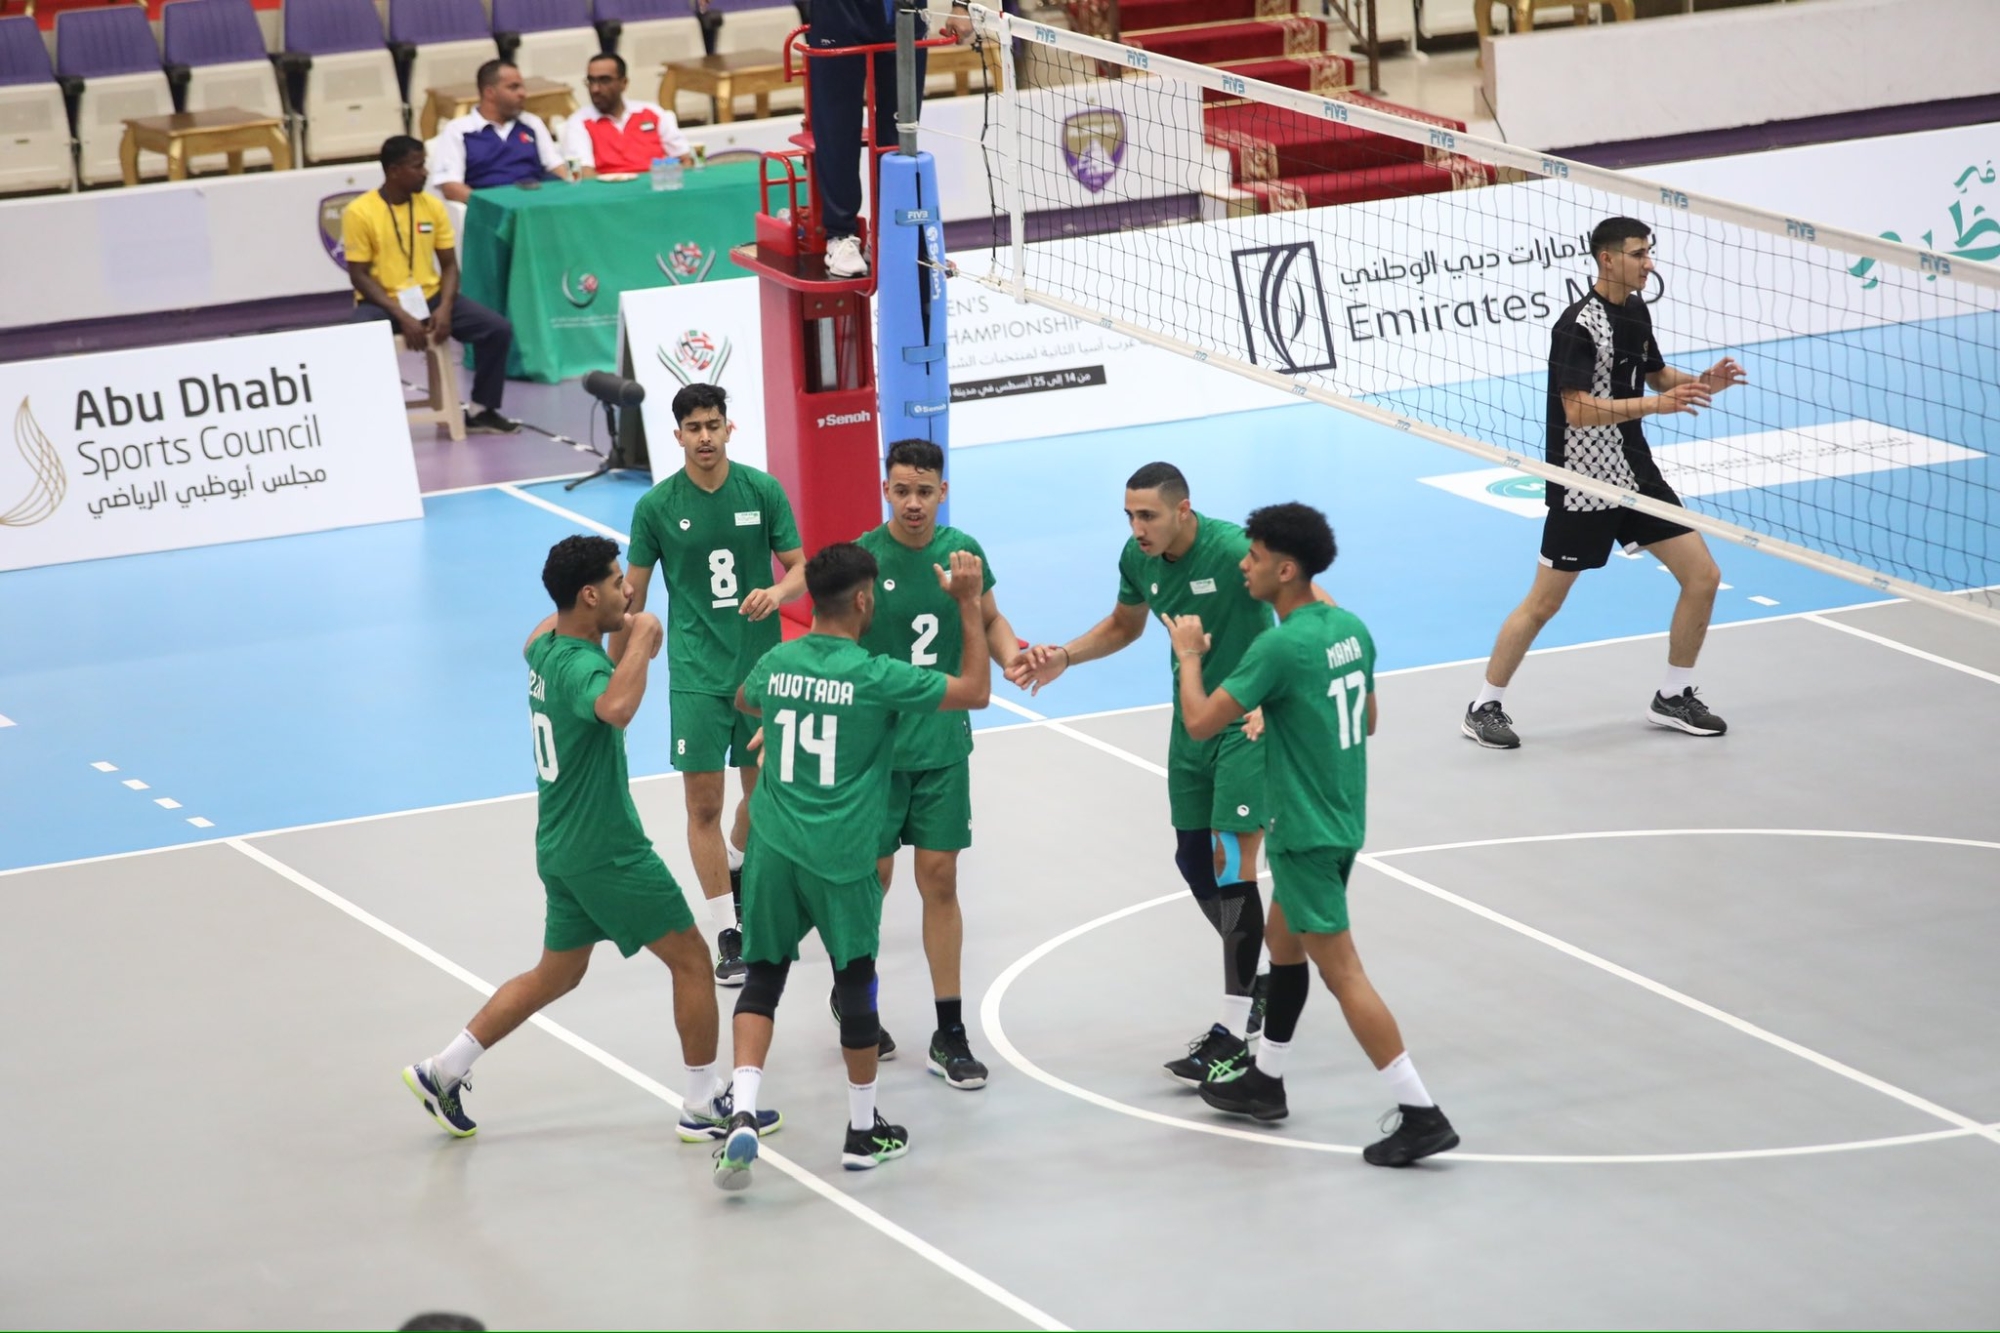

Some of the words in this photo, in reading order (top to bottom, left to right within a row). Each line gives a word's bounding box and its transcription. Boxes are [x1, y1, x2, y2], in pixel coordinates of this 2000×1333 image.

[1127, 49, 1149, 69] FIVB
[1222, 74, 1245, 94] FIVB
[1324, 101, 1348, 122] FIVB
[1430, 129, 1455, 149] FIVB
[1542, 157, 1569, 179] FIVB
[1660, 187, 1689, 209] FIVB
[907, 210, 929, 220] FIVB
[1785, 218, 1816, 242] FIVB
[1444, 249, 1500, 280] دبي
[1919, 251, 1951, 276] FIVB
[947, 295, 989, 318] EN'S
[1346, 290, 1551, 341] Emirates
[947, 317, 1083, 345] HAMPIONSHIP
[75, 387, 164, 430] Abu
[178, 363, 313, 418] Dhabi
[826, 410, 871, 427] Senoh
[77, 436, 192, 480] Sports
[199, 414, 322, 461] Council
[176, 465, 254, 509] أبوظبي
[262, 464, 327, 493] مجلس
[87, 480, 167, 519] الرياضي
[708, 549, 738, 598] 8
[911, 613, 938, 665] 2
[767, 672, 854, 706] MUQTADA
[1327, 670, 1366, 750] 17
[530, 706, 559, 783] 0
[677, 739, 686, 755] 8
[774, 709, 838, 786] 14
